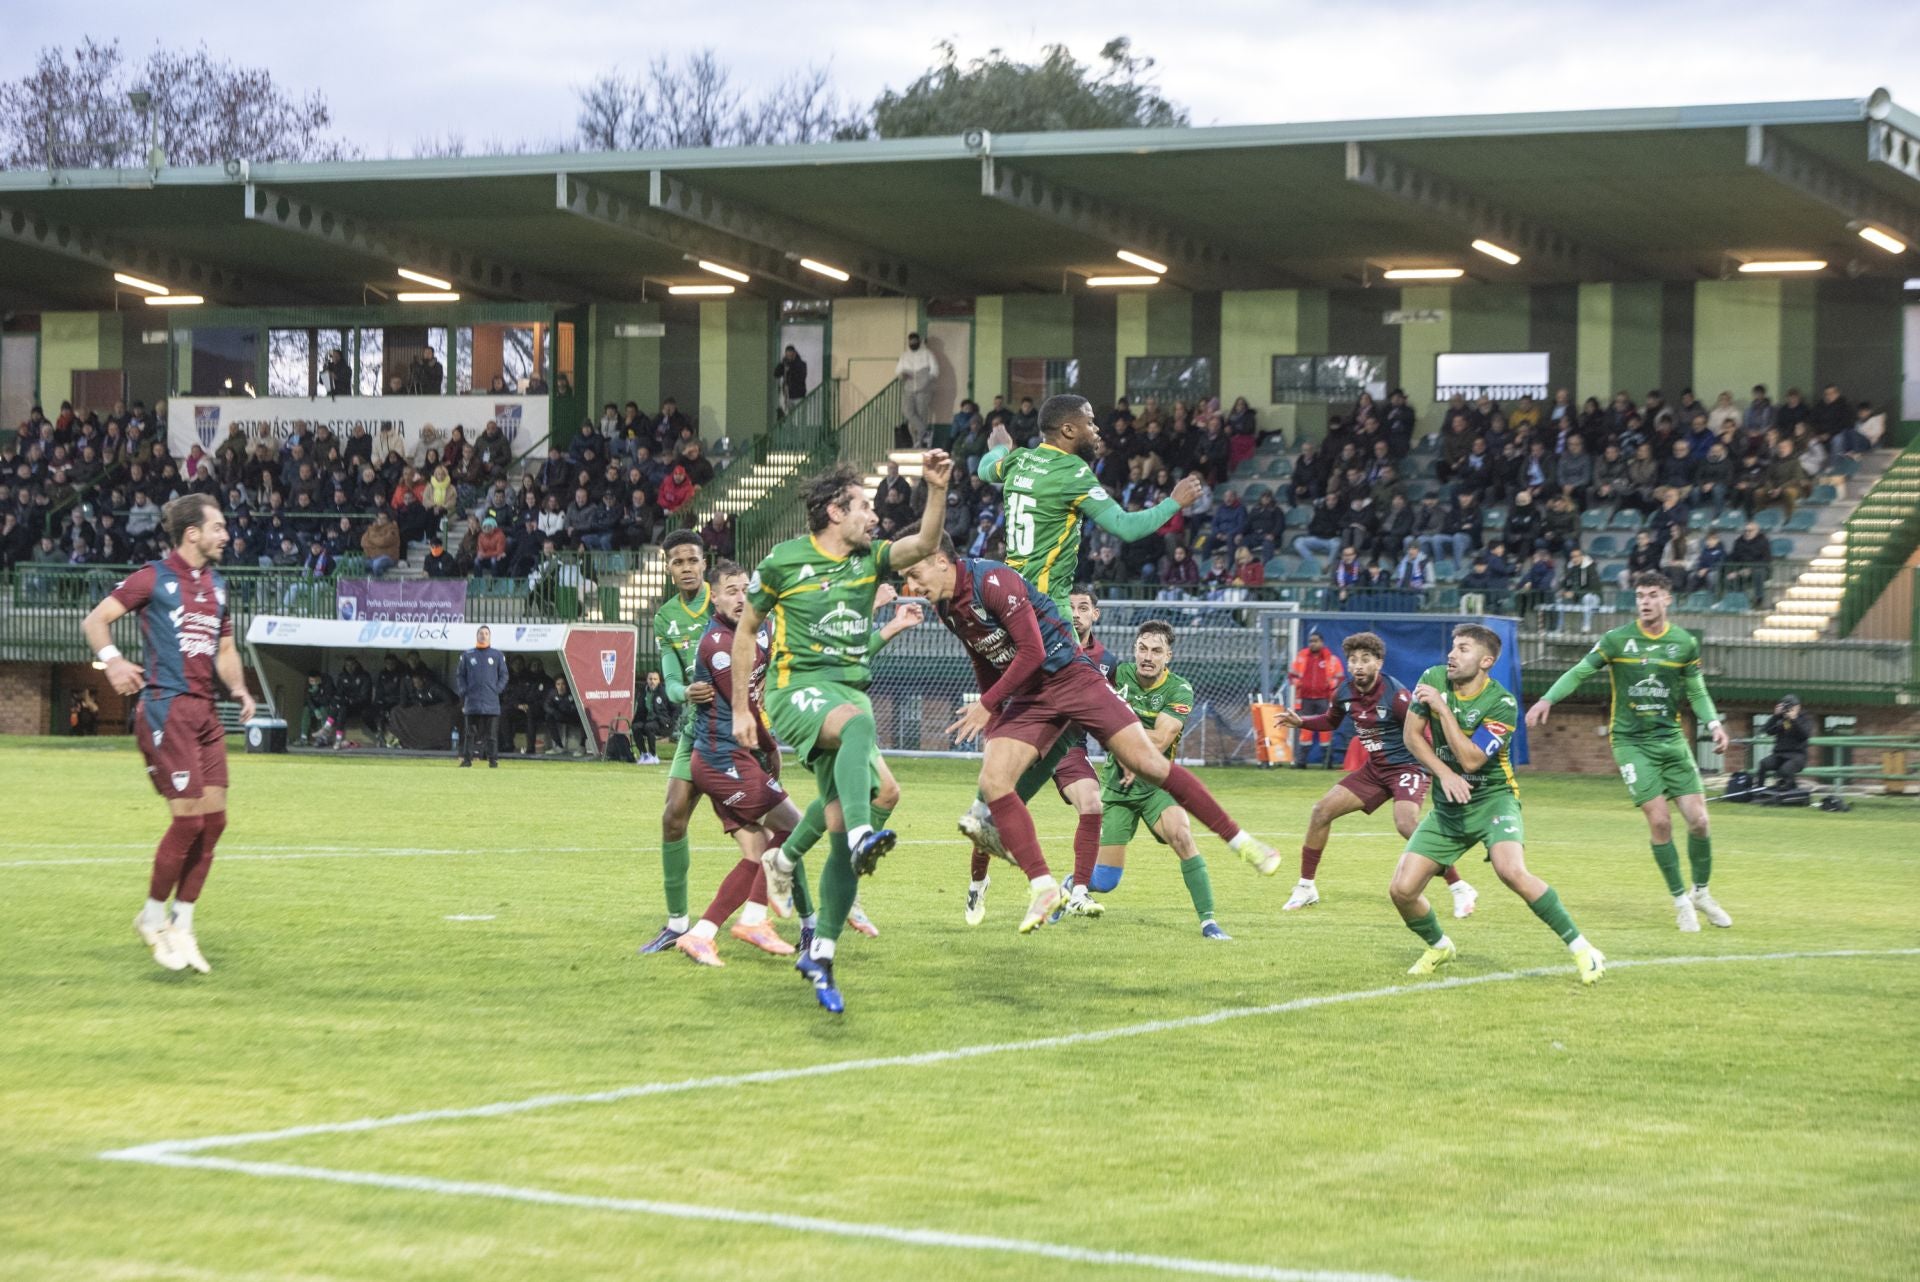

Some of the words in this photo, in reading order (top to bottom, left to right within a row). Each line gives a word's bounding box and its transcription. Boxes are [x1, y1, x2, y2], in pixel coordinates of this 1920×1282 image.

[236, 415, 320, 439] GIMÁSTCA
[1007, 492, 1037, 556] 15
[380, 620, 449, 644] drylock
[1485, 739, 1500, 756] C
[1399, 772, 1420, 789] 21
